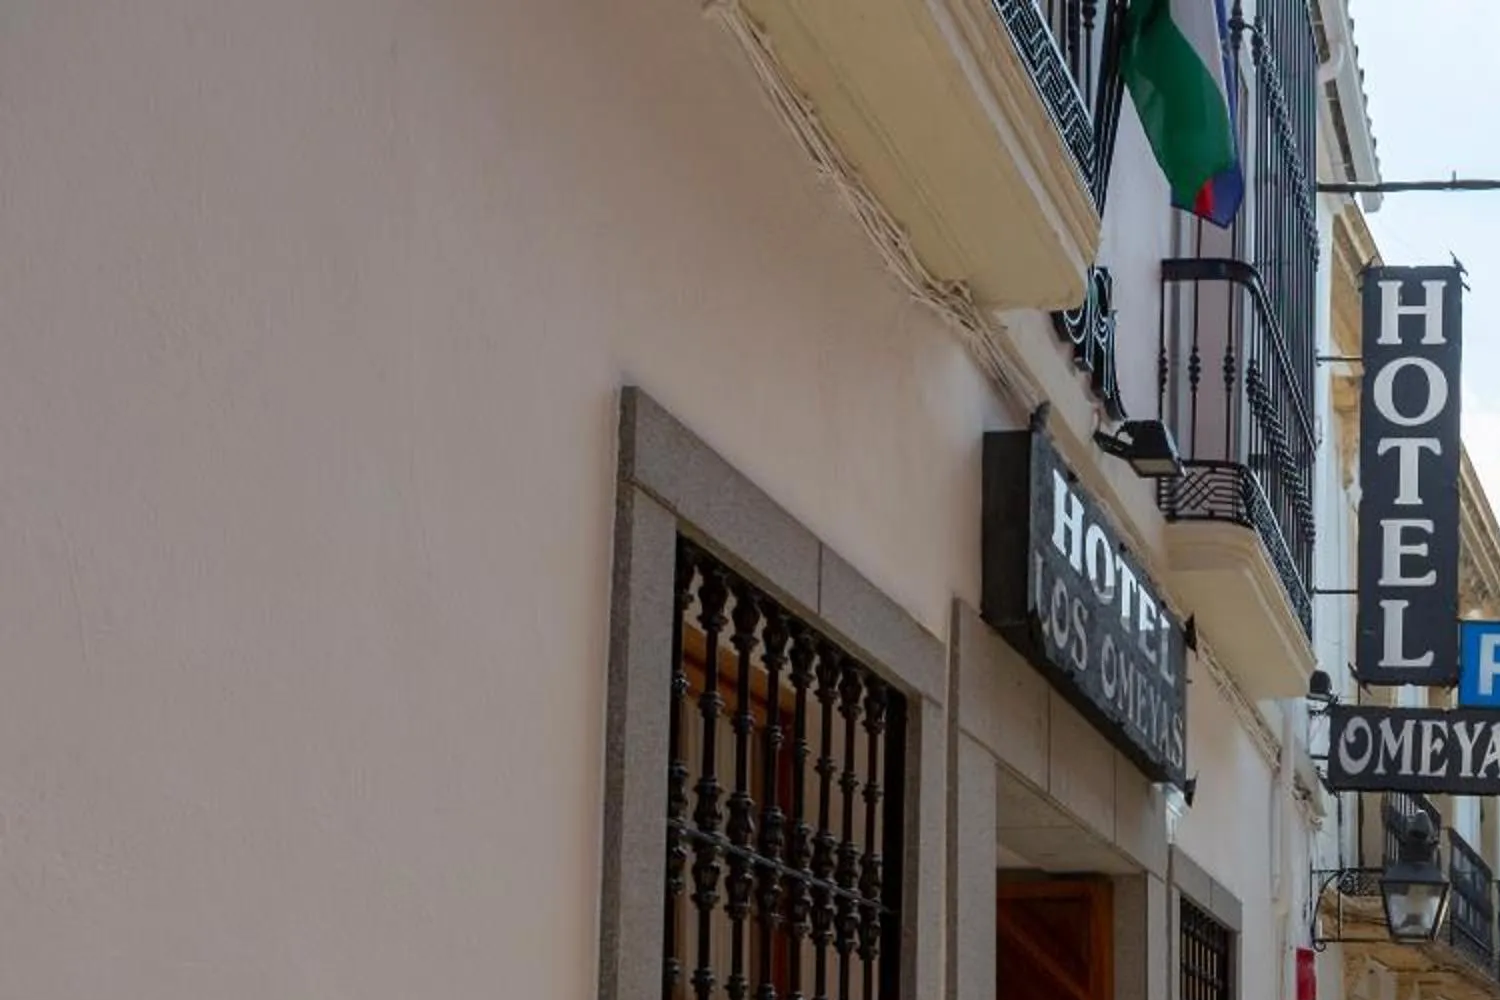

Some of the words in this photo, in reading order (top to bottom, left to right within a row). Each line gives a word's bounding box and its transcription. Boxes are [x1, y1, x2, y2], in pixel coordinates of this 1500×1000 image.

[1051, 468, 1176, 687] HOTEL
[1373, 279, 1448, 669] HOTEL
[1034, 549, 1090, 671] LOS
[1101, 634, 1185, 769] OMEYAS
